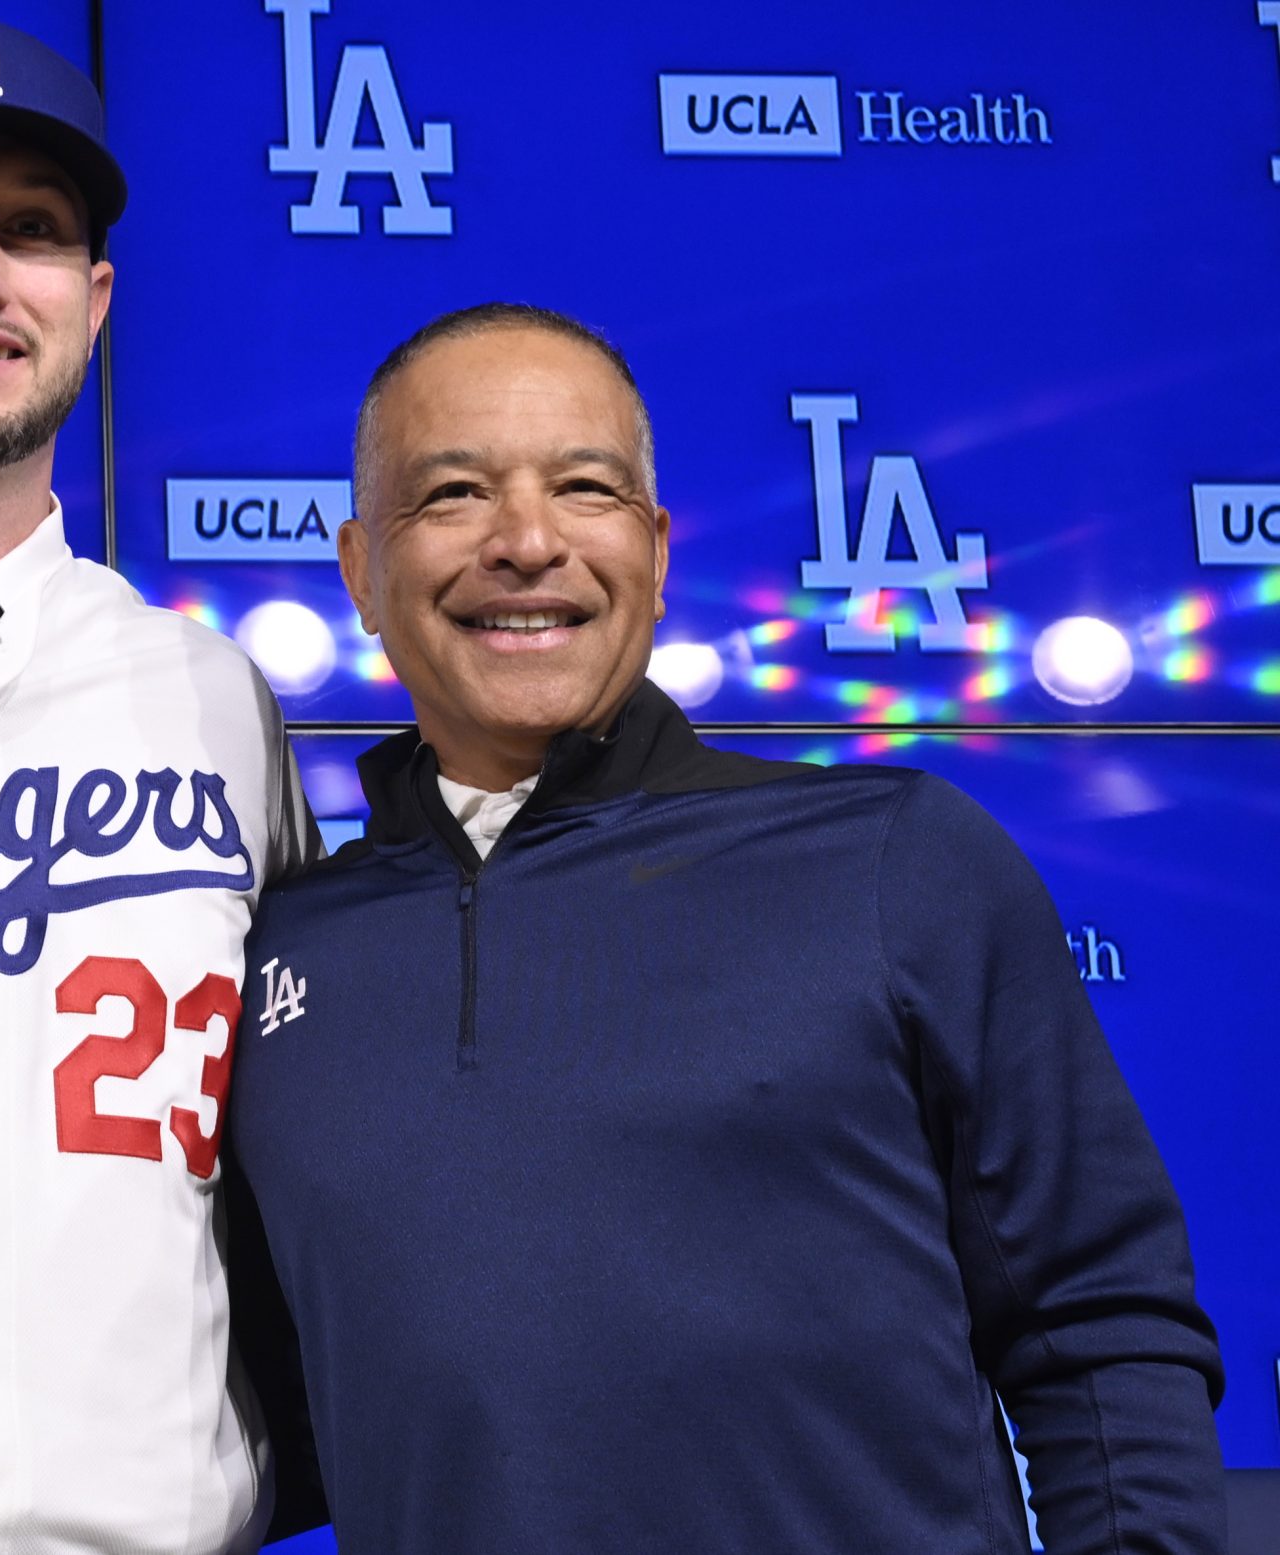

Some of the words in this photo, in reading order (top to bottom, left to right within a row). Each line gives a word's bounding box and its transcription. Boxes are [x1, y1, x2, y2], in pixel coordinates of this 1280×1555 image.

[265, 0, 453, 234] LA
[687, 95, 818, 135] UCLA
[855, 91, 1052, 144] Health
[195, 500, 329, 540] UCLA
[791, 394, 988, 651] LA
[1222, 504, 1280, 545] UC
[260, 957, 306, 1037] LA
[53, 955, 243, 1180] 23
